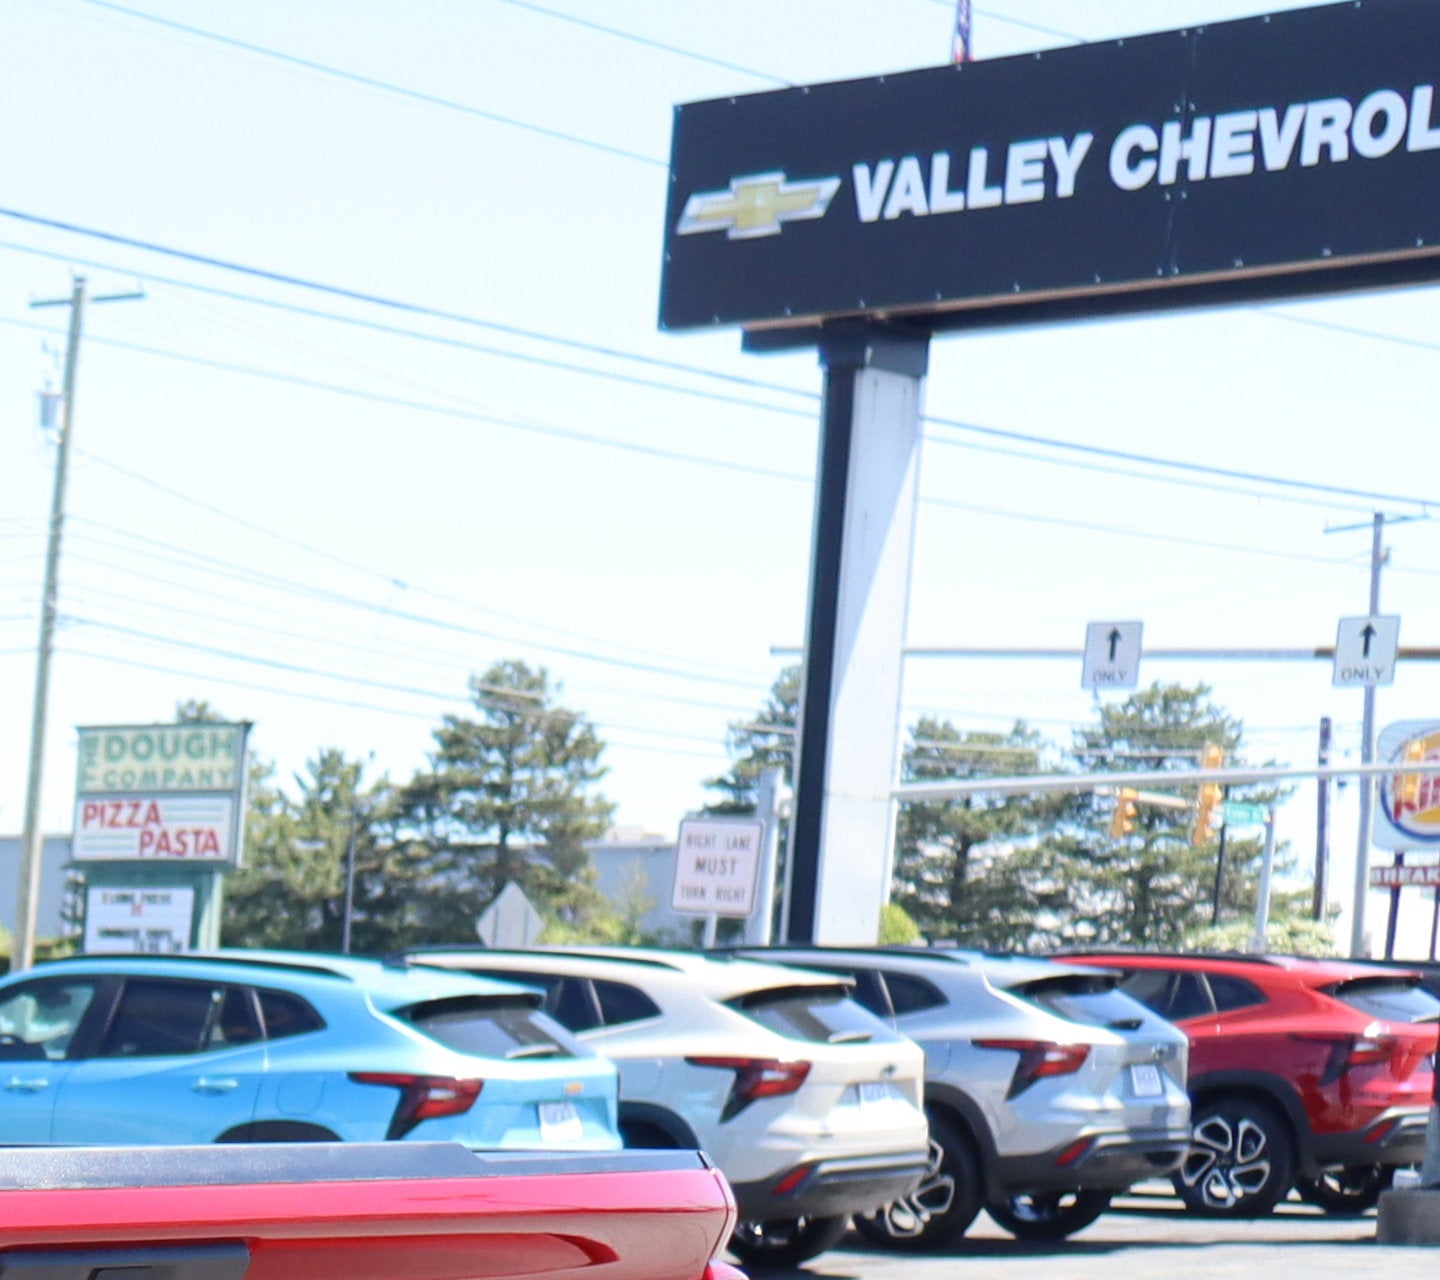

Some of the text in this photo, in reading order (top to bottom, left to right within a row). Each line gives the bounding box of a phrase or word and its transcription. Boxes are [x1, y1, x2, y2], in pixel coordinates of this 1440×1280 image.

[853, 132, 1093, 222] VALLEY
[1093, 671, 1127, 684] ONLY
[1342, 667, 1385, 681] ONLY
[104, 733, 233, 761] DOUGH
[103, 768, 231, 789] COMPANY
[83, 800, 160, 828] PIZZA
[140, 829, 221, 857] PASTA
[686, 833, 752, 850] RIGHT LANE
[695, 856, 737, 876] MUST
[681, 884, 745, 901] TURN RIGHT
